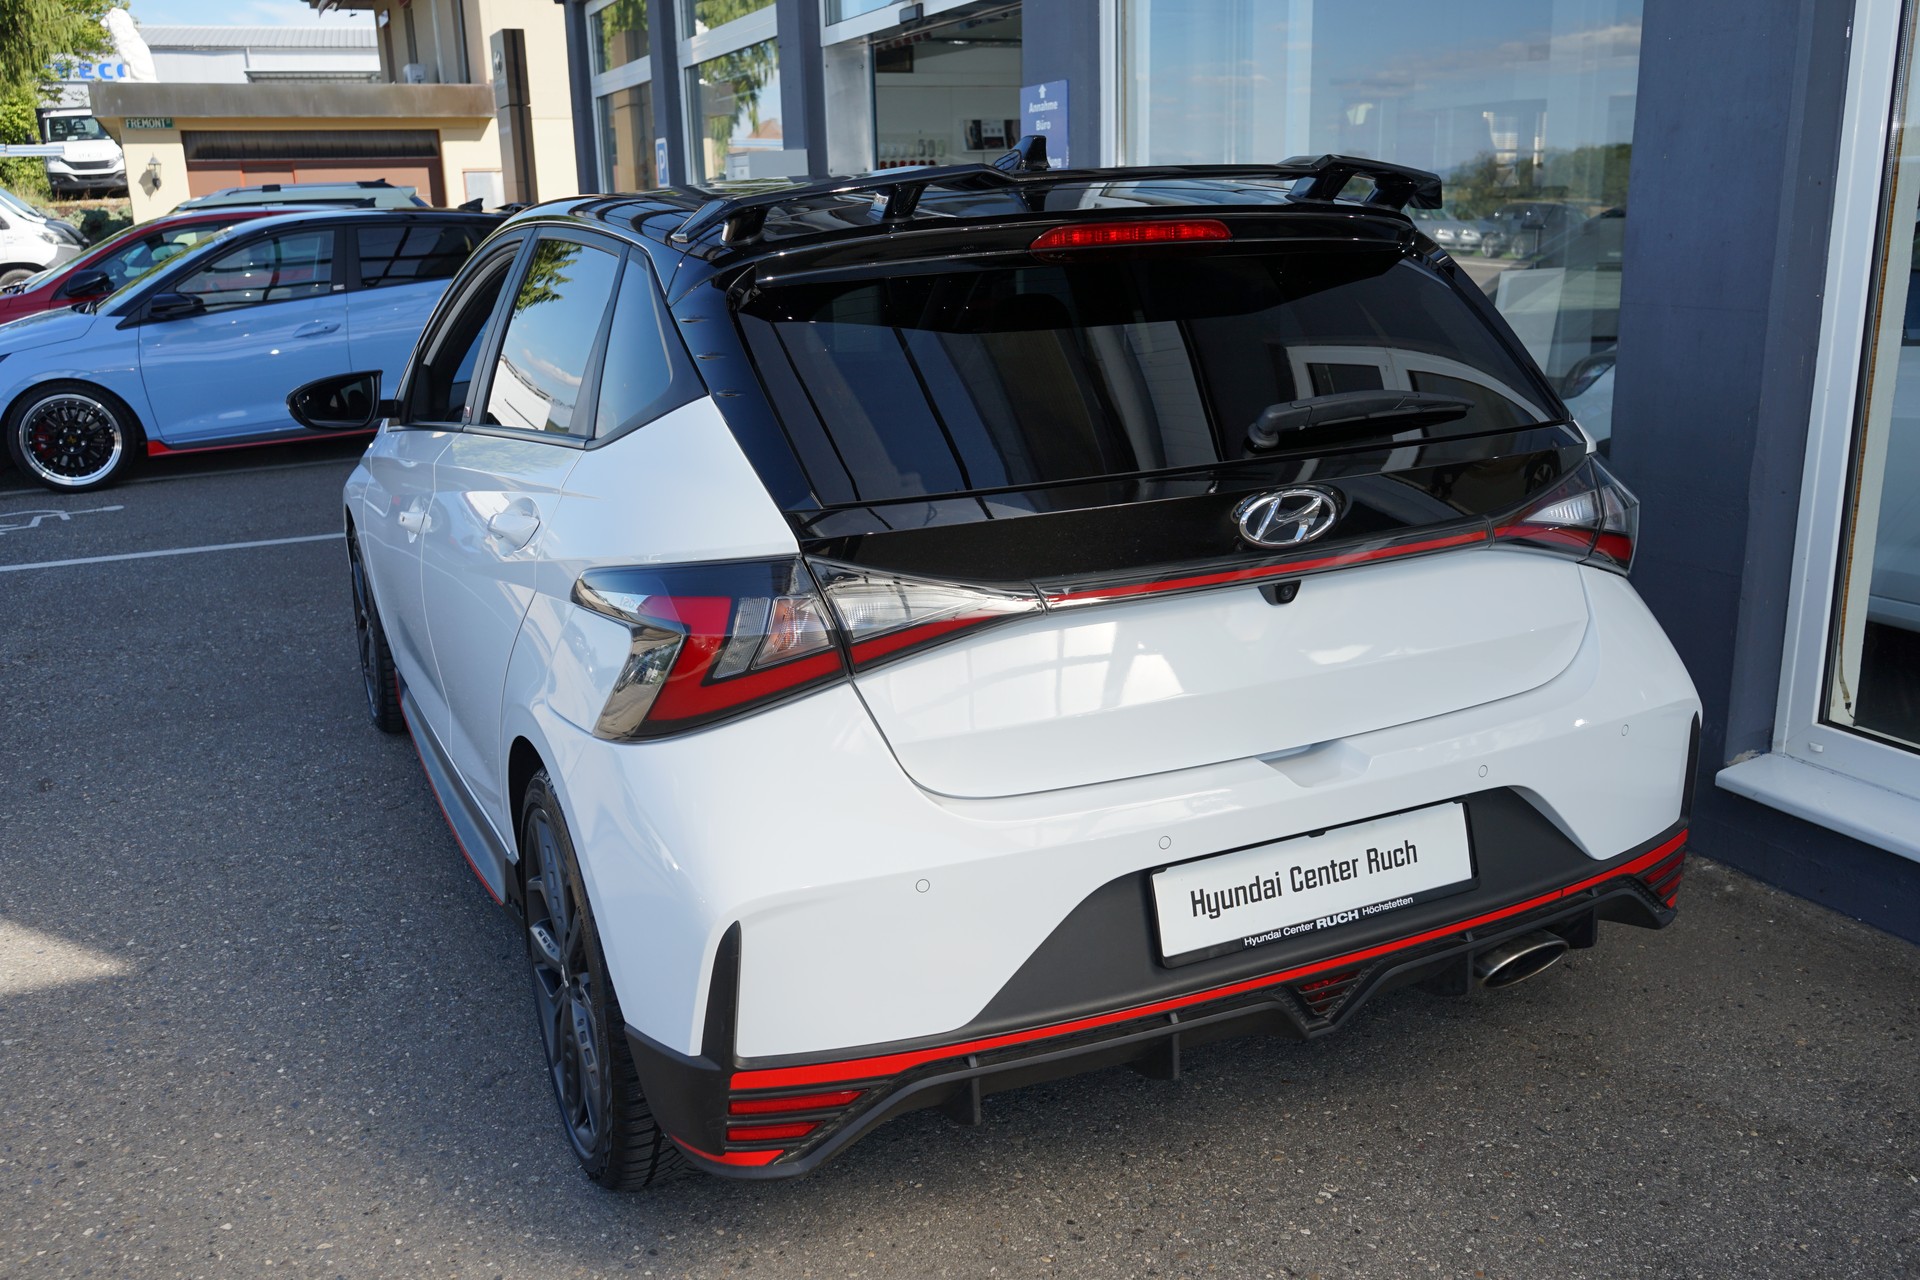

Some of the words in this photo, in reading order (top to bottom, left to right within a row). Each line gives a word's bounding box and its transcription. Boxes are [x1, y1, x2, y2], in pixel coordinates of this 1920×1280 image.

[44, 63, 126, 79] VEC
[1028, 100, 1058, 113] Annahme
[126, 118, 165, 129] FREMONT
[1035, 120, 1051, 131] Büro
[658, 149, 666, 180] P
[1190, 871, 1283, 920] Hyundai
[1289, 857, 1359, 893] Center
[1365, 839, 1418, 875] Ruch
[1244, 925, 1282, 947] Hyundai
[1283, 921, 1315, 936] Center
[1316, 909, 1360, 930] RUCH
[1362, 895, 1414, 916] Höchstetten
